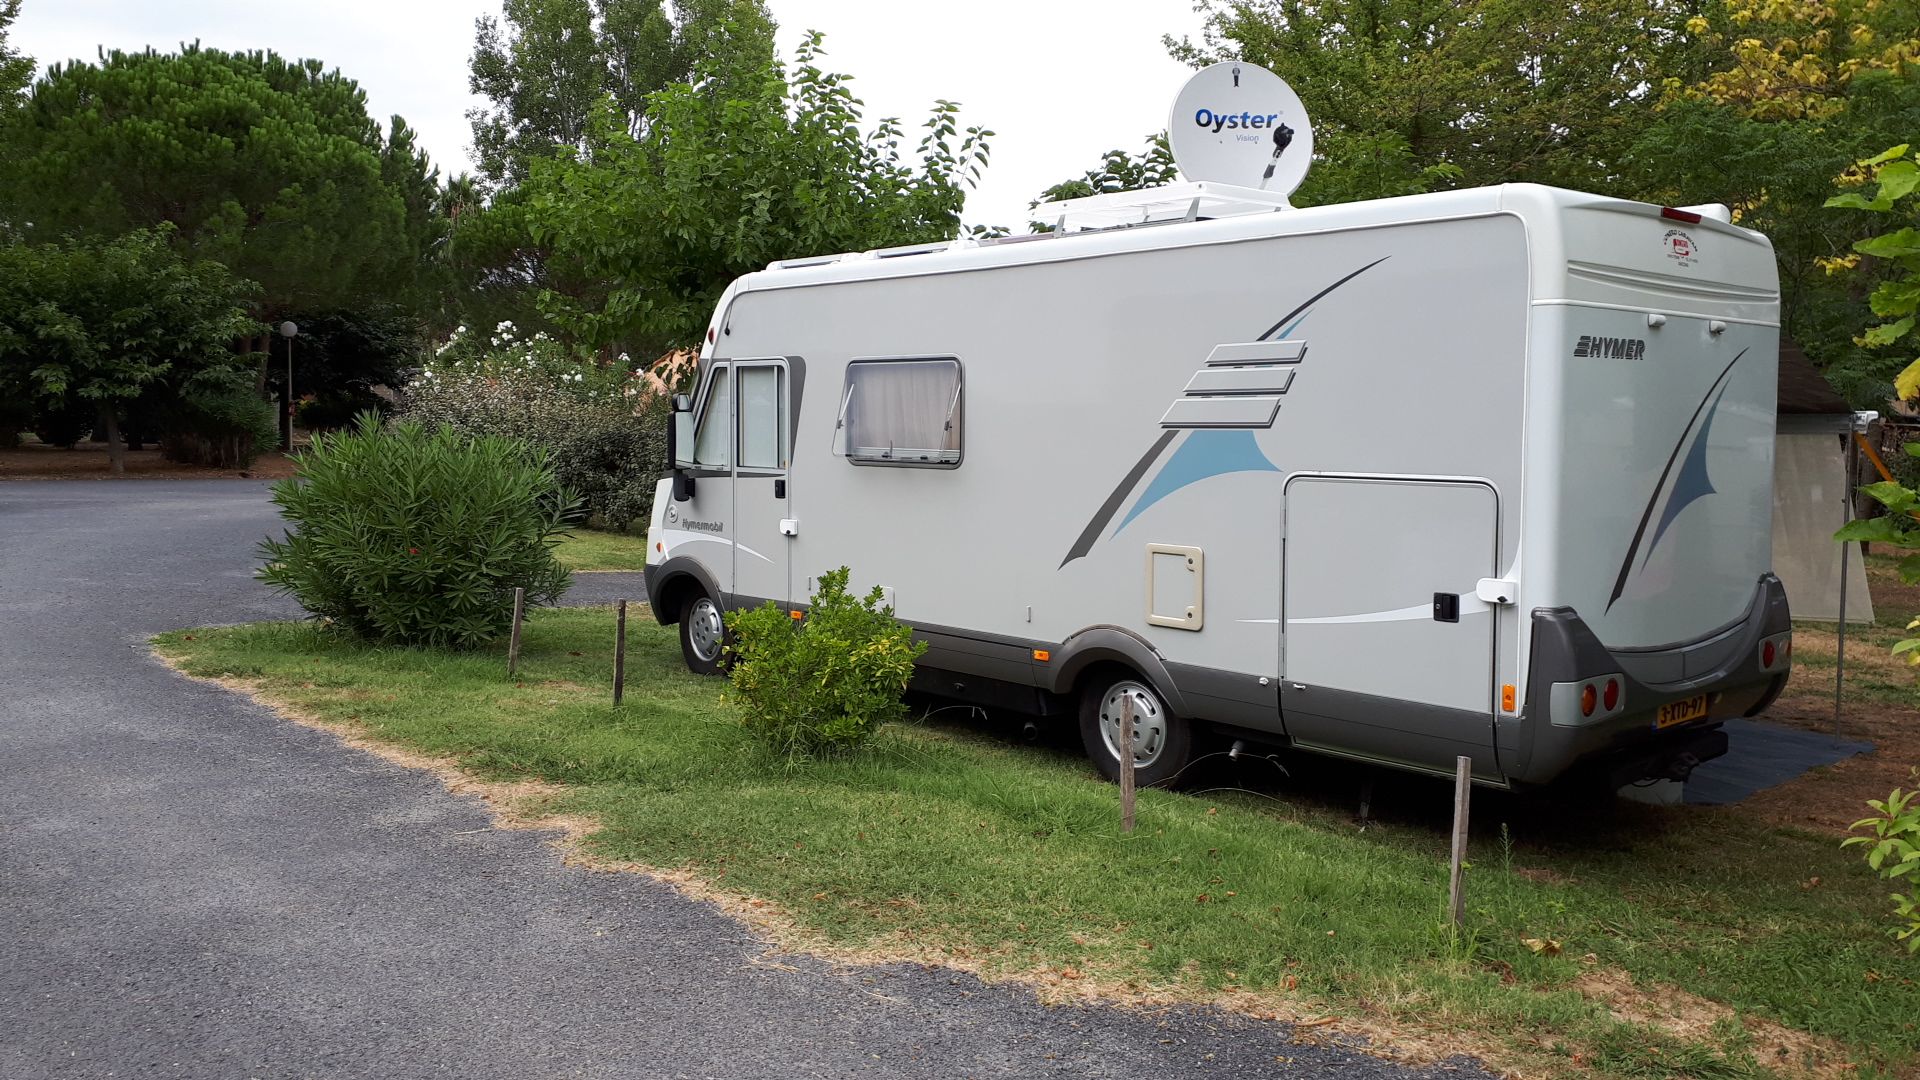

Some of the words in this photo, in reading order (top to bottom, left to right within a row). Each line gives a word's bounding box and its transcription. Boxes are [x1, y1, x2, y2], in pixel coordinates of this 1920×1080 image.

[1195, 108, 1278, 133] Oyster
[1236, 134, 1260, 142] Vision
[1590, 336, 1646, 360] HYMER
[682, 518, 724, 533] Hymermobil
